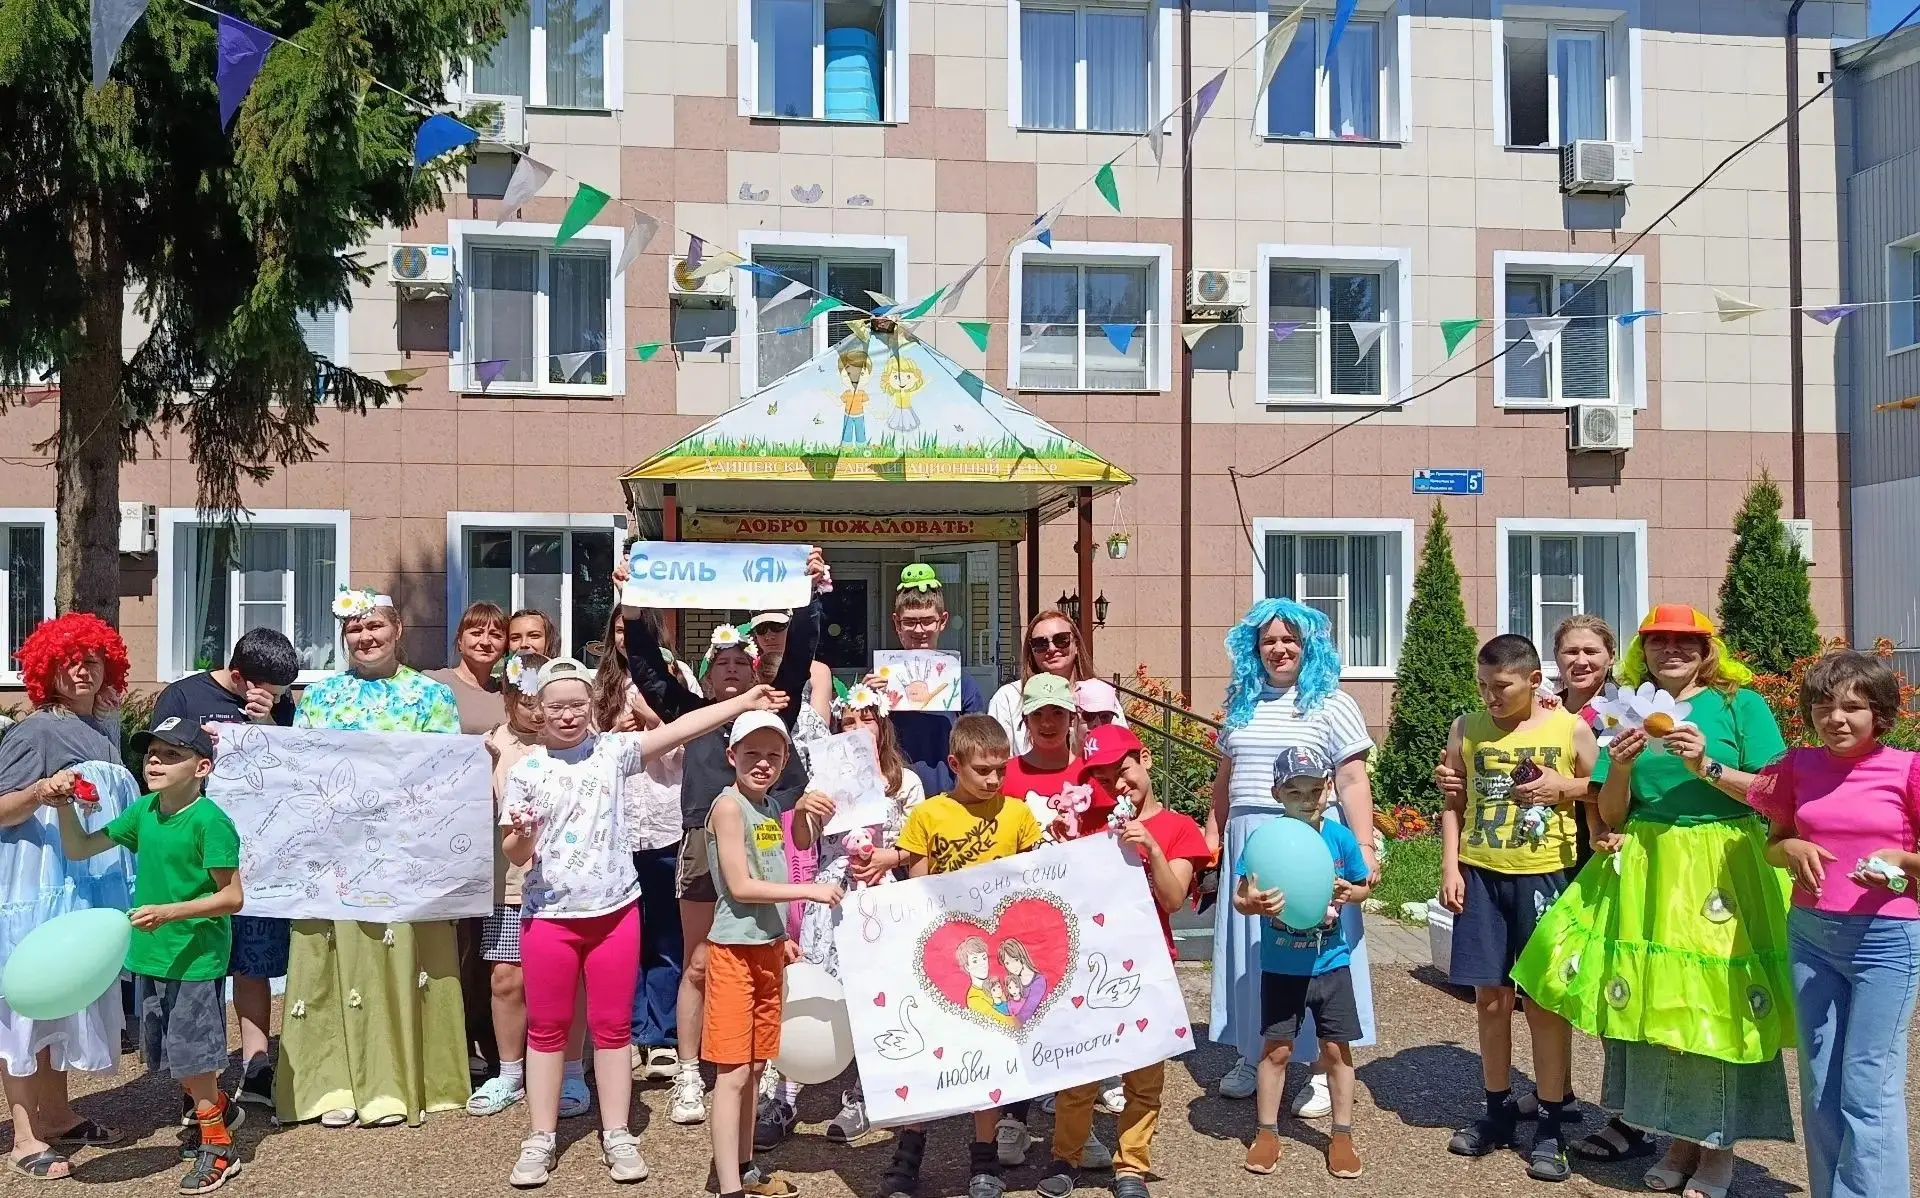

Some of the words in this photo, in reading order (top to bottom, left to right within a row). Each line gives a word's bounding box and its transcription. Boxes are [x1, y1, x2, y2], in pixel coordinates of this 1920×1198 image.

[736, 518, 808, 534] ДОБРО
[818, 518, 975, 535] ПОЖАЛОВАТЬ!
[629, 553, 717, 582] Семь
[858, 892, 882, 943] 8
[936, 1050, 990, 1090] любви
[1006, 1057, 1018, 1075] и
